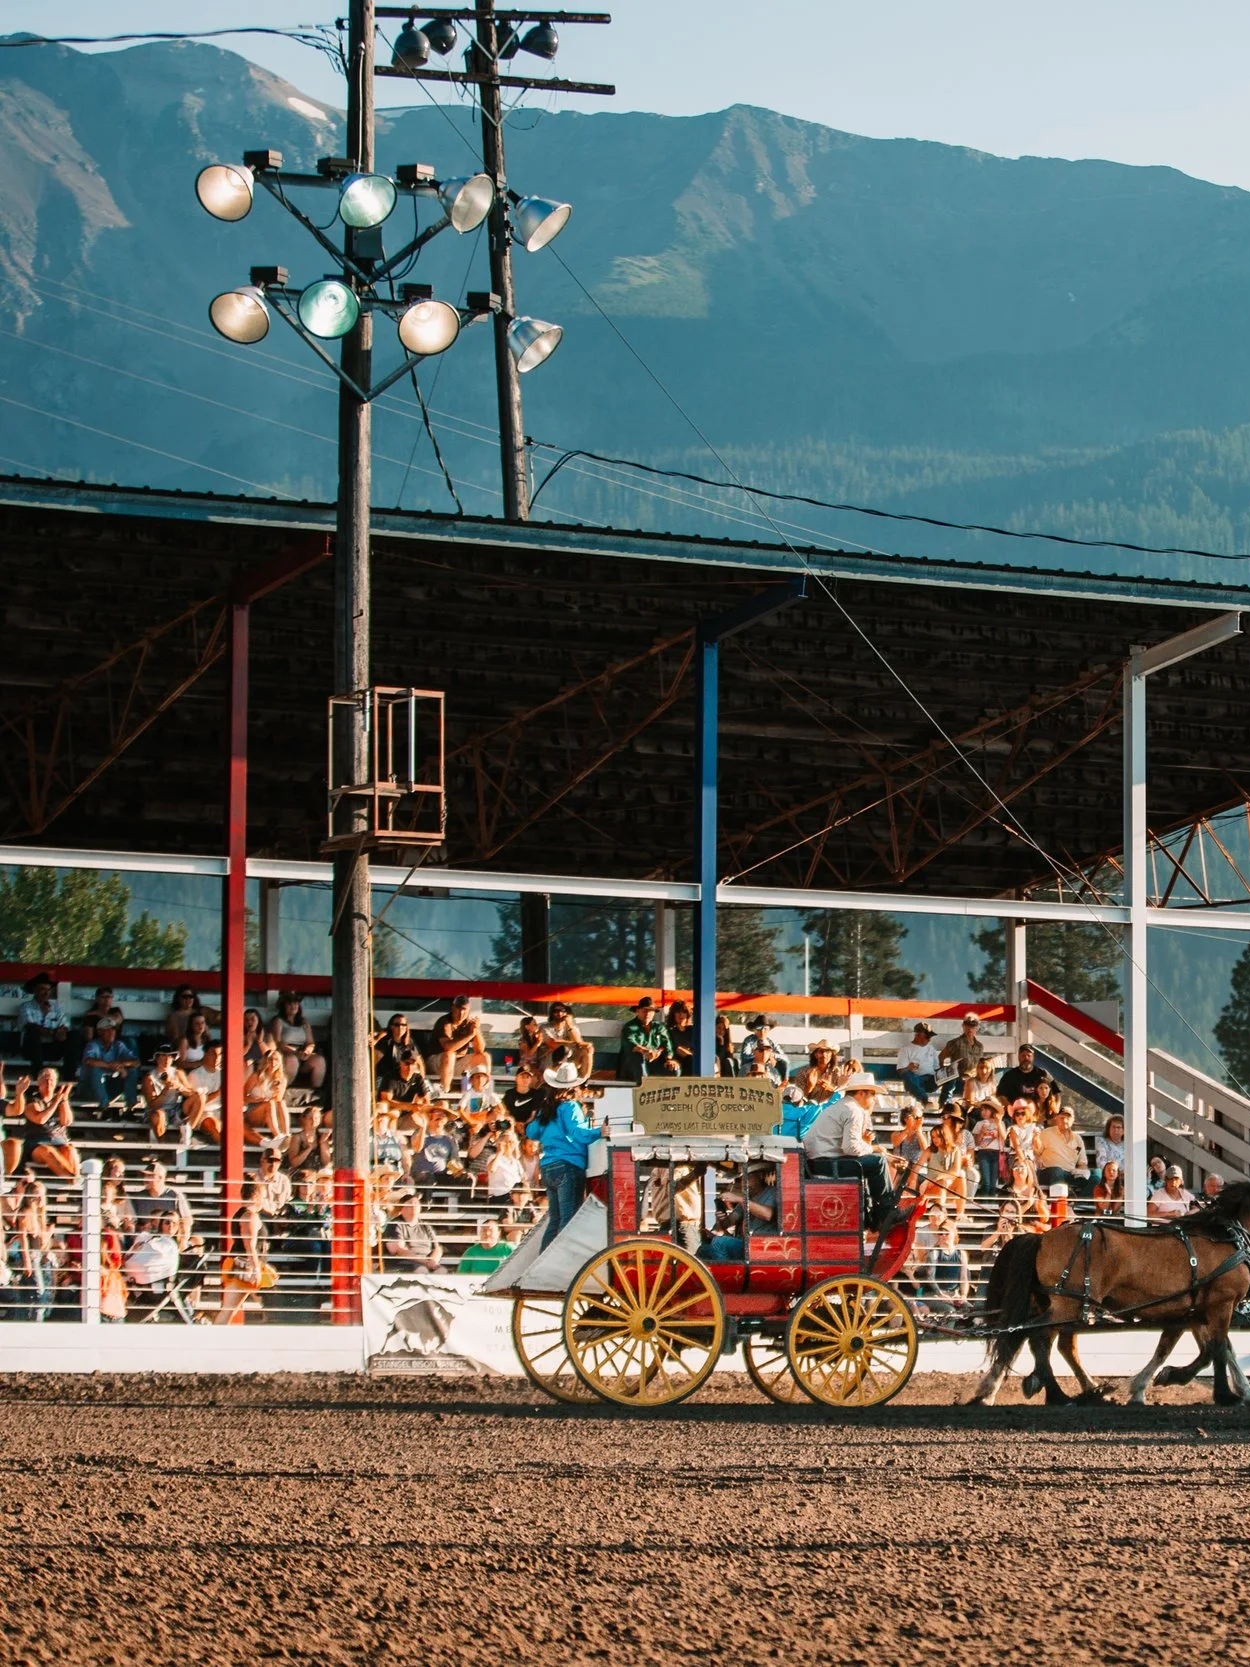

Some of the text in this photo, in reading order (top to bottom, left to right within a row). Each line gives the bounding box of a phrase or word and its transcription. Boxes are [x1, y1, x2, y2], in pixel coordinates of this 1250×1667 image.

[639, 1084, 775, 1106] CHIEF JOSEPH DAYS
[660, 1103, 693, 1112] JOSEPH
[655, 1122, 763, 1131] ALWAYS LAST FULL WEEK IN JULY
